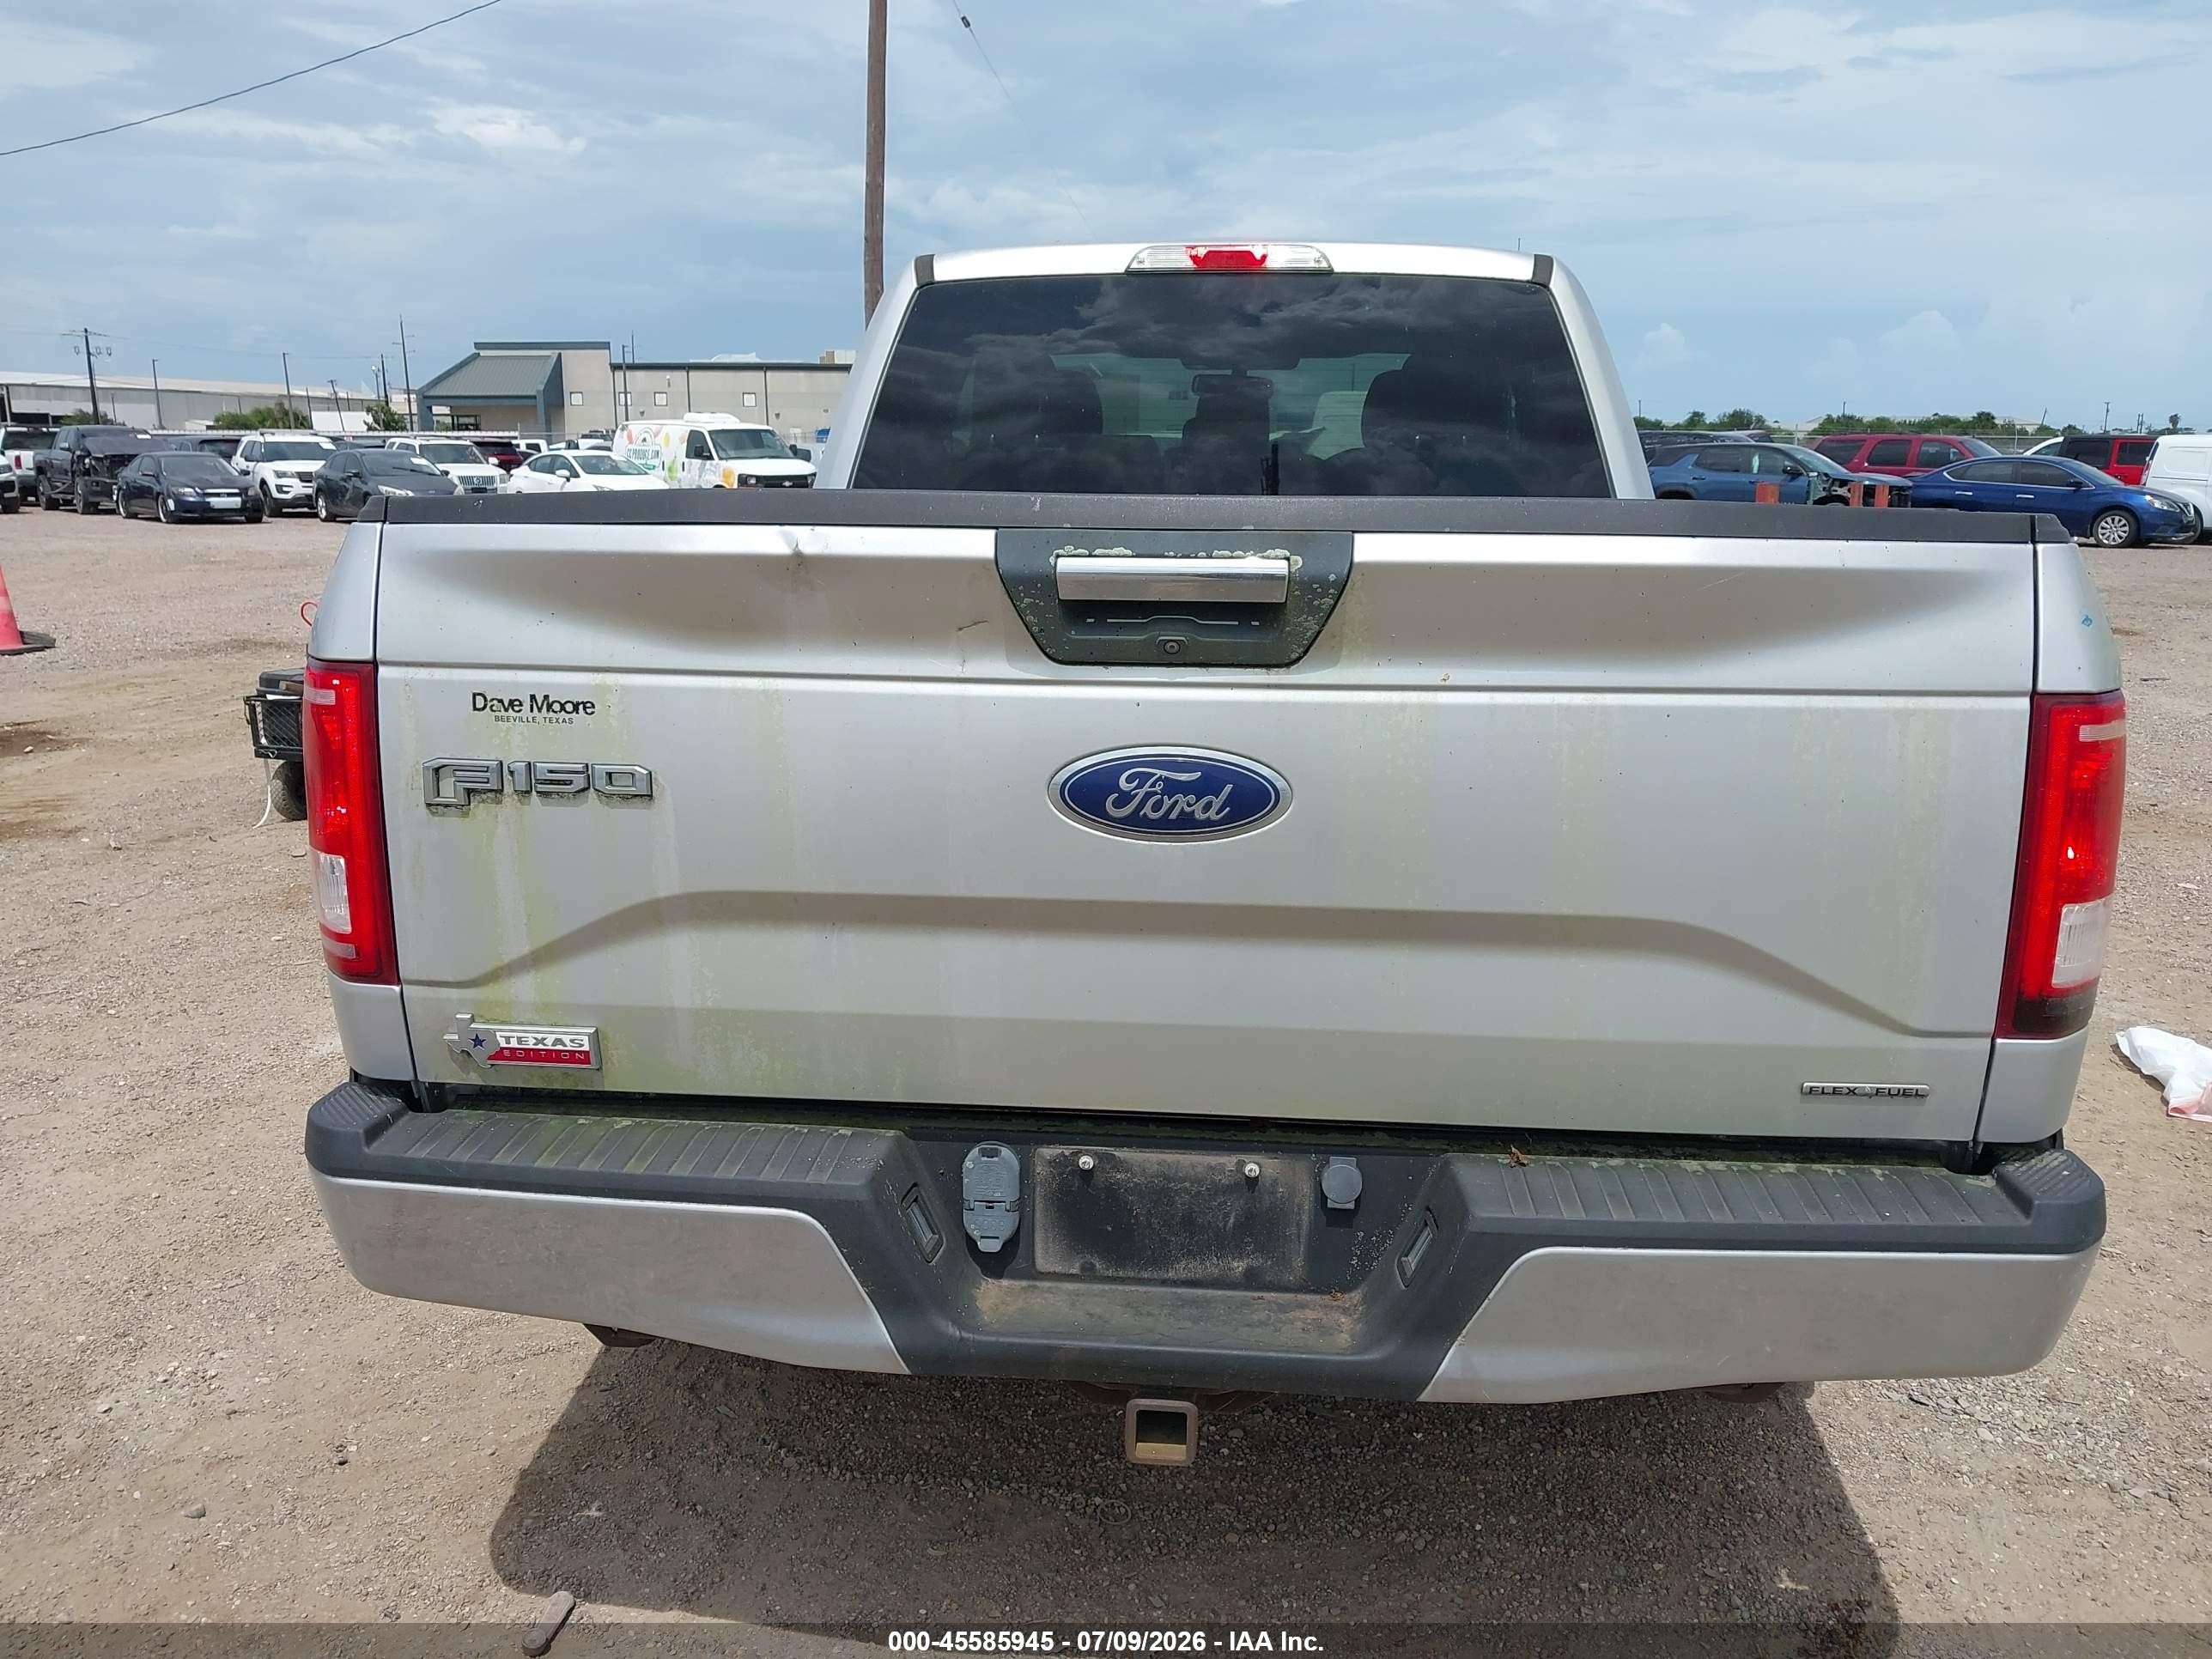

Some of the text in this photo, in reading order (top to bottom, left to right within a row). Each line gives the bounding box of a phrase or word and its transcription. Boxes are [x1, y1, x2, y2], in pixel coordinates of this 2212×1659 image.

[471, 691, 596, 715] Dave Moore
[494, 714, 574, 726] BEEVILLE, TEXAS
[422, 757, 653, 805] F150
[1105, 767, 1234, 820] Ford
[499, 1035, 585, 1048] TEXAS
[502, 1049, 585, 1060] EDITION
[1808, 1086, 1929, 1097] FLEX FUEL
